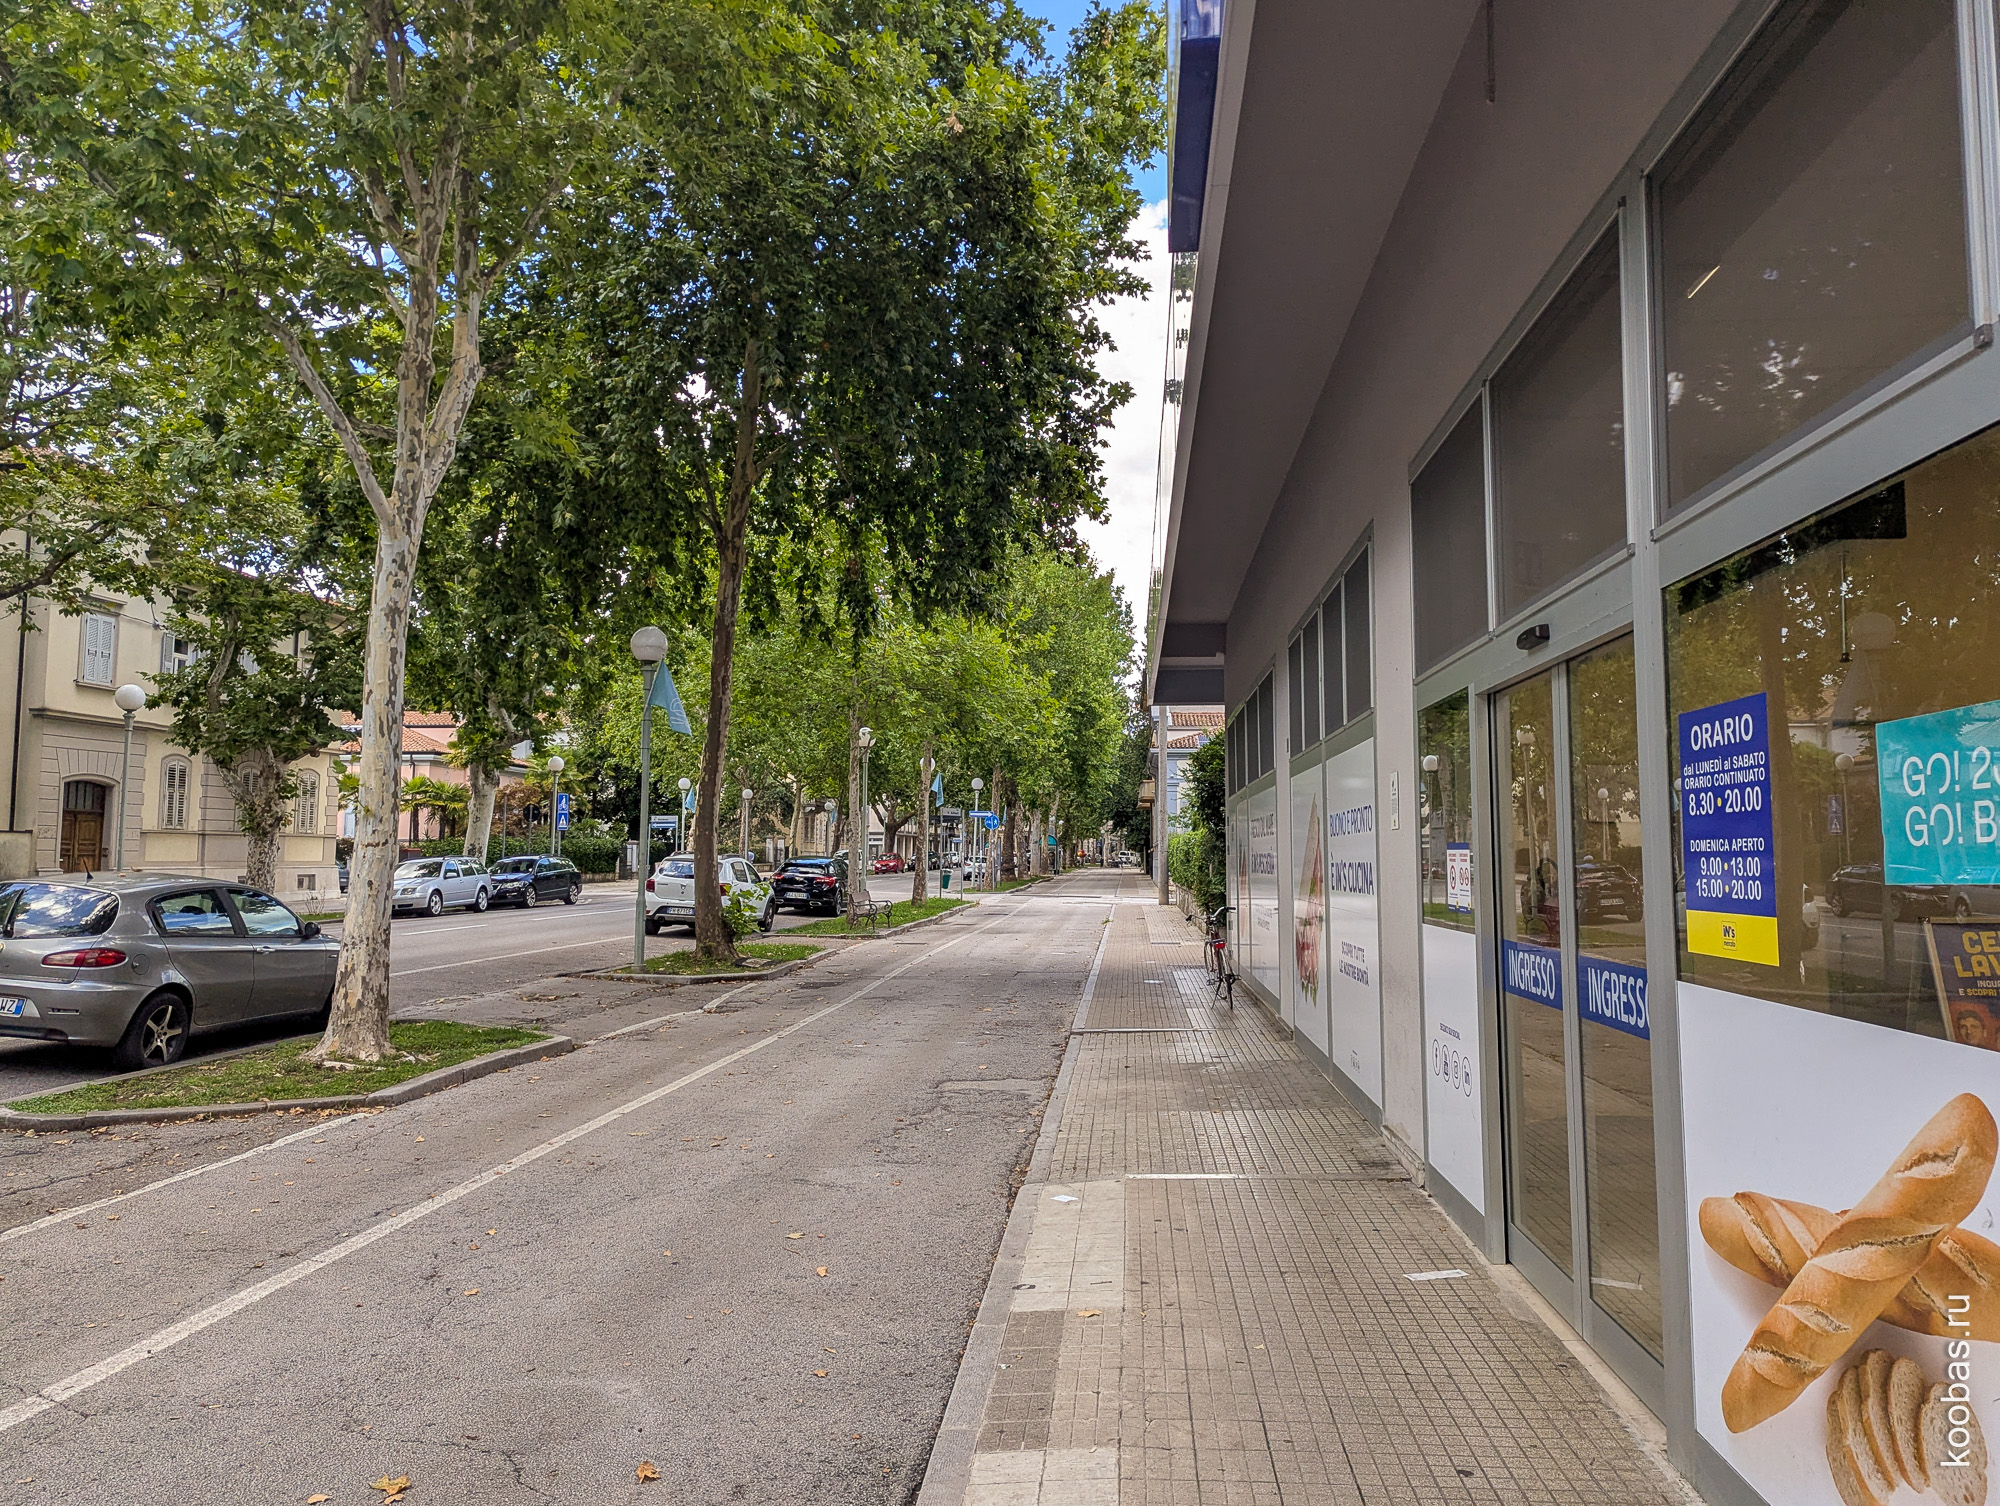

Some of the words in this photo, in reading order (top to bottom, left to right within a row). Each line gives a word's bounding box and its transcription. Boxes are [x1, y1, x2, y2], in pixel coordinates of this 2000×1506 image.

[1690, 713, 1753, 751] ORARIO
[1683, 763, 1694, 776] dal
[1695, 756, 1722, 774] LUNEDÌ
[1723, 757, 1731, 770] al
[1732, 751, 1766, 769] SABATO
[1684, 775, 1712, 790] ORARIO
[1713, 767, 1766, 786] CONTINUATO
[1689, 791, 1714, 816] 8.30
[1724, 786, 1762, 813] 20.00
[1329, 811, 1346, 837] BUONO
[1350, 804, 1373, 834] PRONTO
[1690, 838, 1730, 852] DOMENICA
[1731, 837, 1765, 852] APERTO
[1347, 861, 1375, 896] CUCINA
[1700, 856, 1722, 876] 9.00
[1730, 856, 1761, 877] 13.00
[1696, 878, 1723, 898] 15.00
[1731, 879, 1762, 901] 20.00
[1961, 930, 2000, 954] CE
[1508, 949, 1556, 1000] INGRESSO
[1976, 980, 2000, 988] INQU
[1966, 988, 1997, 996] SCOPRI
